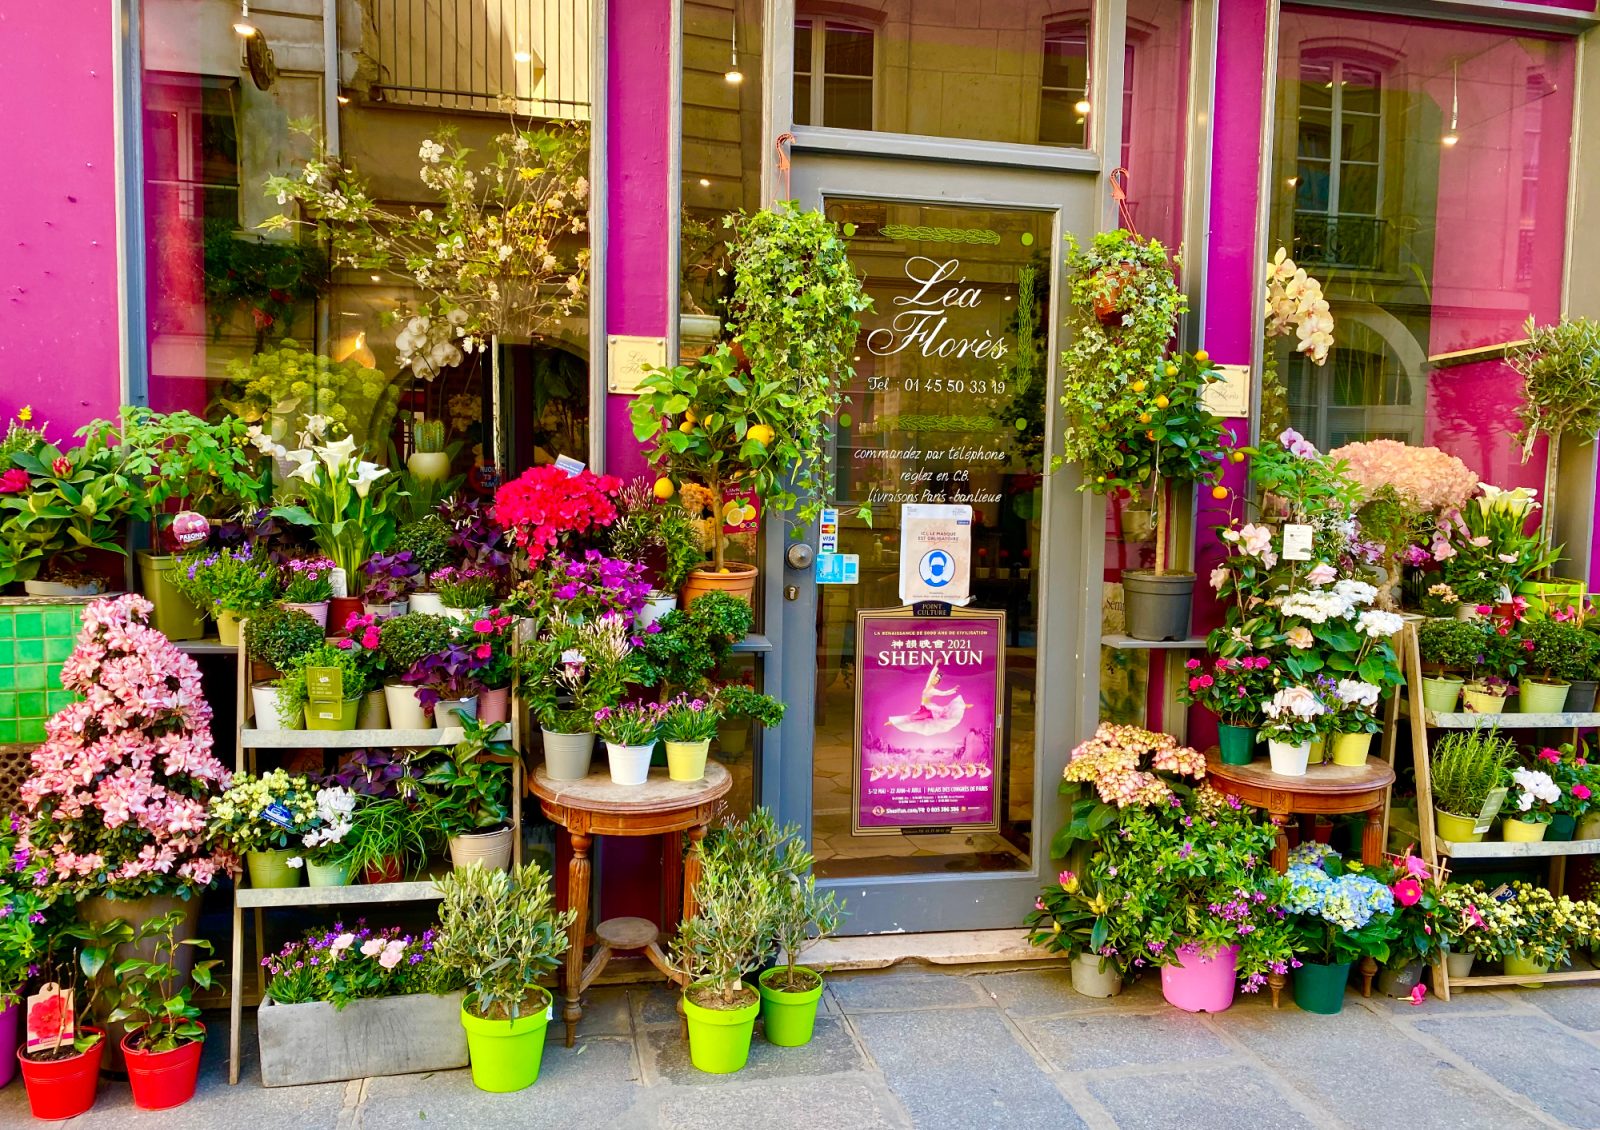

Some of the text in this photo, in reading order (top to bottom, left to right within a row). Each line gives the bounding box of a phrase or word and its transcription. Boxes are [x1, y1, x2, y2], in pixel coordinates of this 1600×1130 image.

[893, 256, 982, 308] Léa
[867, 309, 1008, 360] Florès
[904, 378, 919, 392] 01
[924, 378, 942, 393] 45
[946, 380, 964, 393] 50
[969, 380, 986, 394] 33
[991, 381, 1005, 394] 19
[854, 445, 1005, 463] commandez par téléphone
[936, 472, 950, 482] en
[868, 488, 920, 503] livraisons
[947, 639, 971, 649] 2021
[878, 650, 983, 666] SHEN YUN
